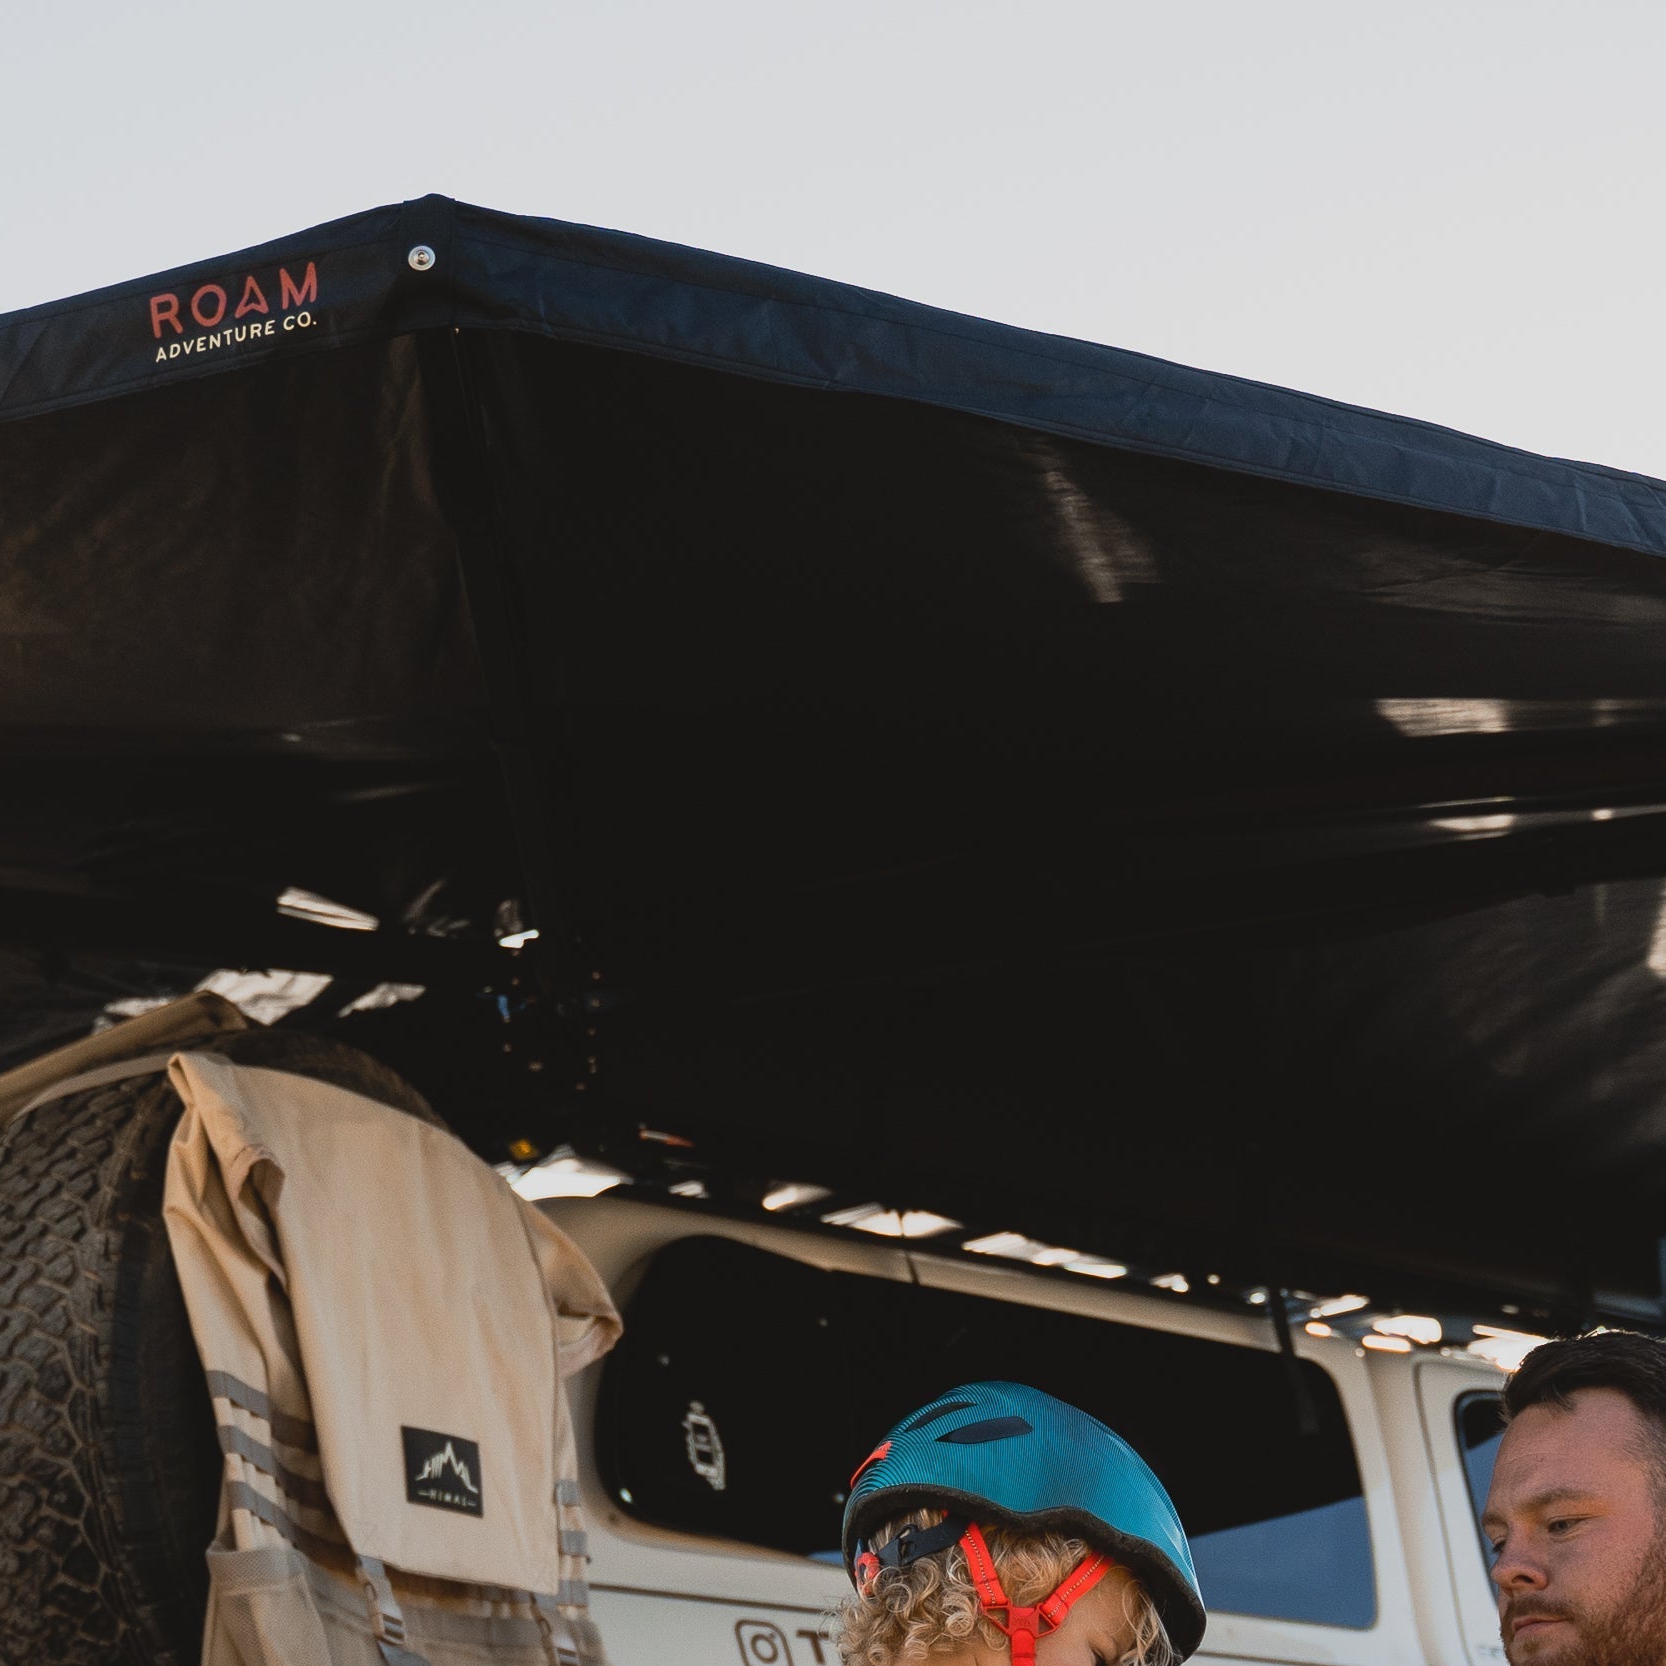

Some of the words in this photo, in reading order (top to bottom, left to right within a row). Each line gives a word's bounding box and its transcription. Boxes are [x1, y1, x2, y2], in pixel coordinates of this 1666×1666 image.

[149, 261, 318, 339] ROAM
[155, 319, 276, 363] ADVENTURE
[282, 311, 317, 332] CO.
